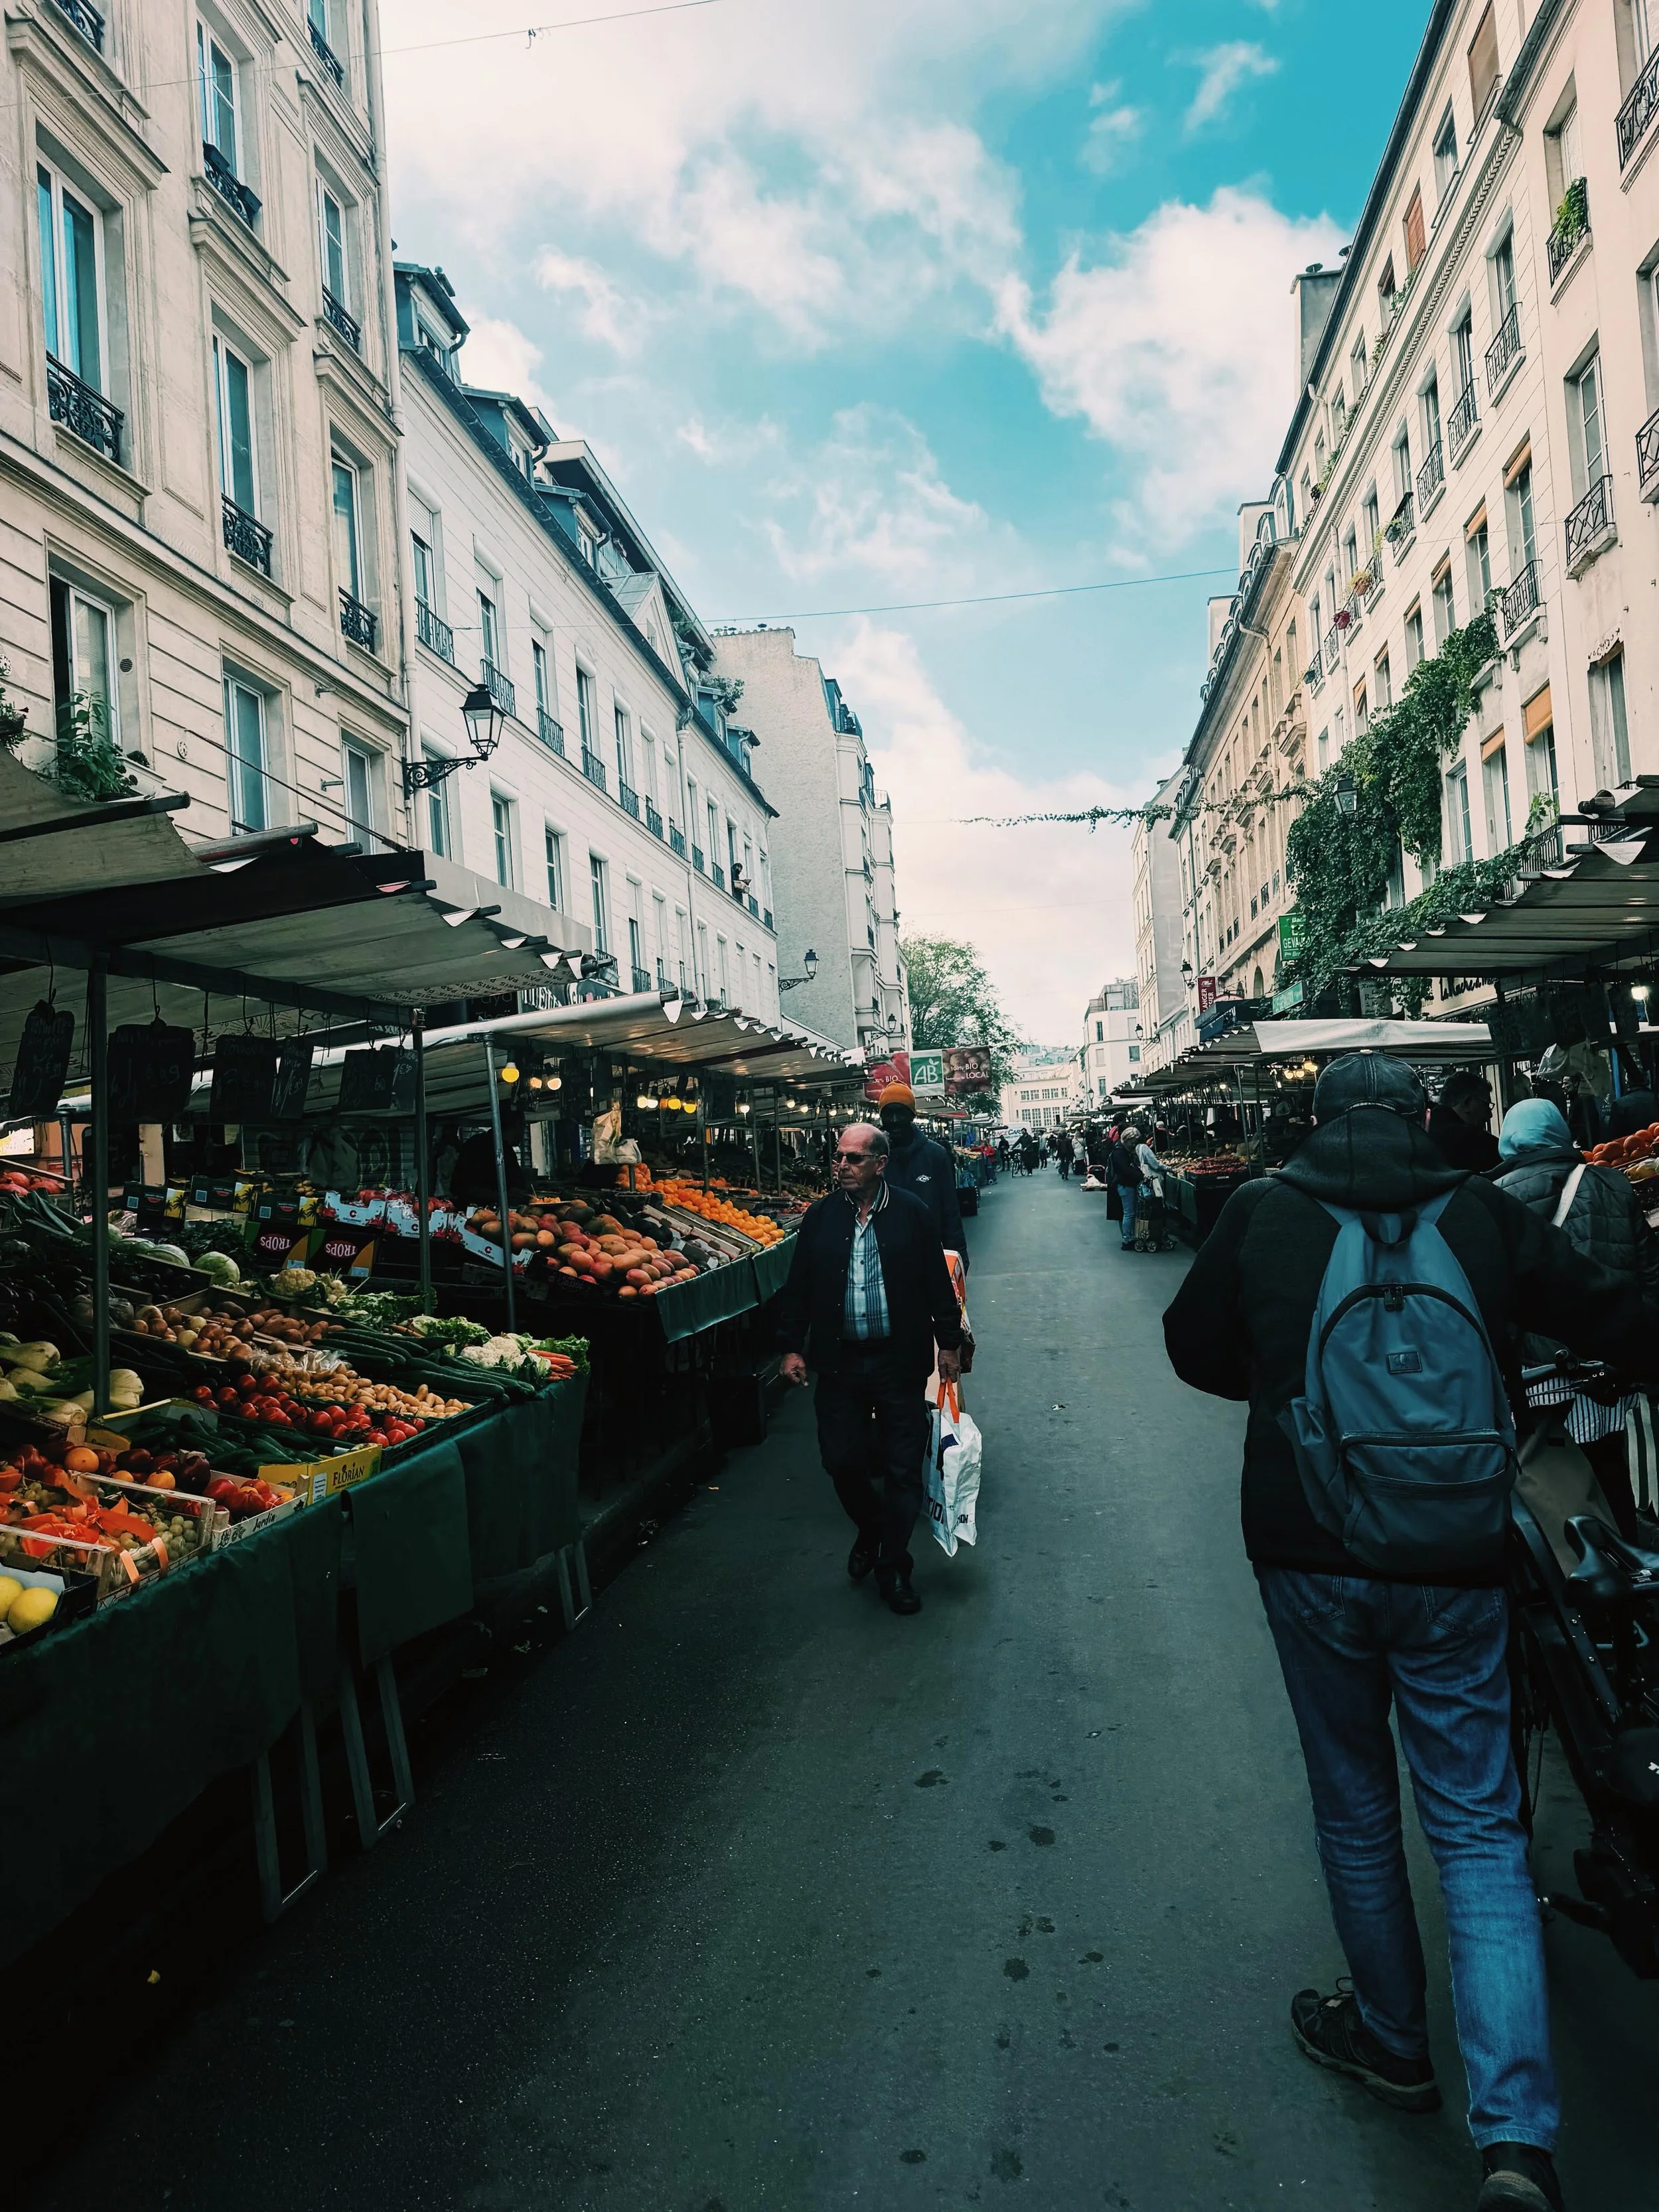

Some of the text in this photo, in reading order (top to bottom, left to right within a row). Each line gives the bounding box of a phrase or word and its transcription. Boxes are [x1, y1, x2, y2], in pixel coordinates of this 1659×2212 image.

[914, 1065, 938, 1084] AB
[259, 1236, 291, 1251] TROPS
[325, 1243, 357, 1258] TROPS
[332, 1461, 365, 1487] FLORIAN
[252, 1512, 276, 1532] Jardin
